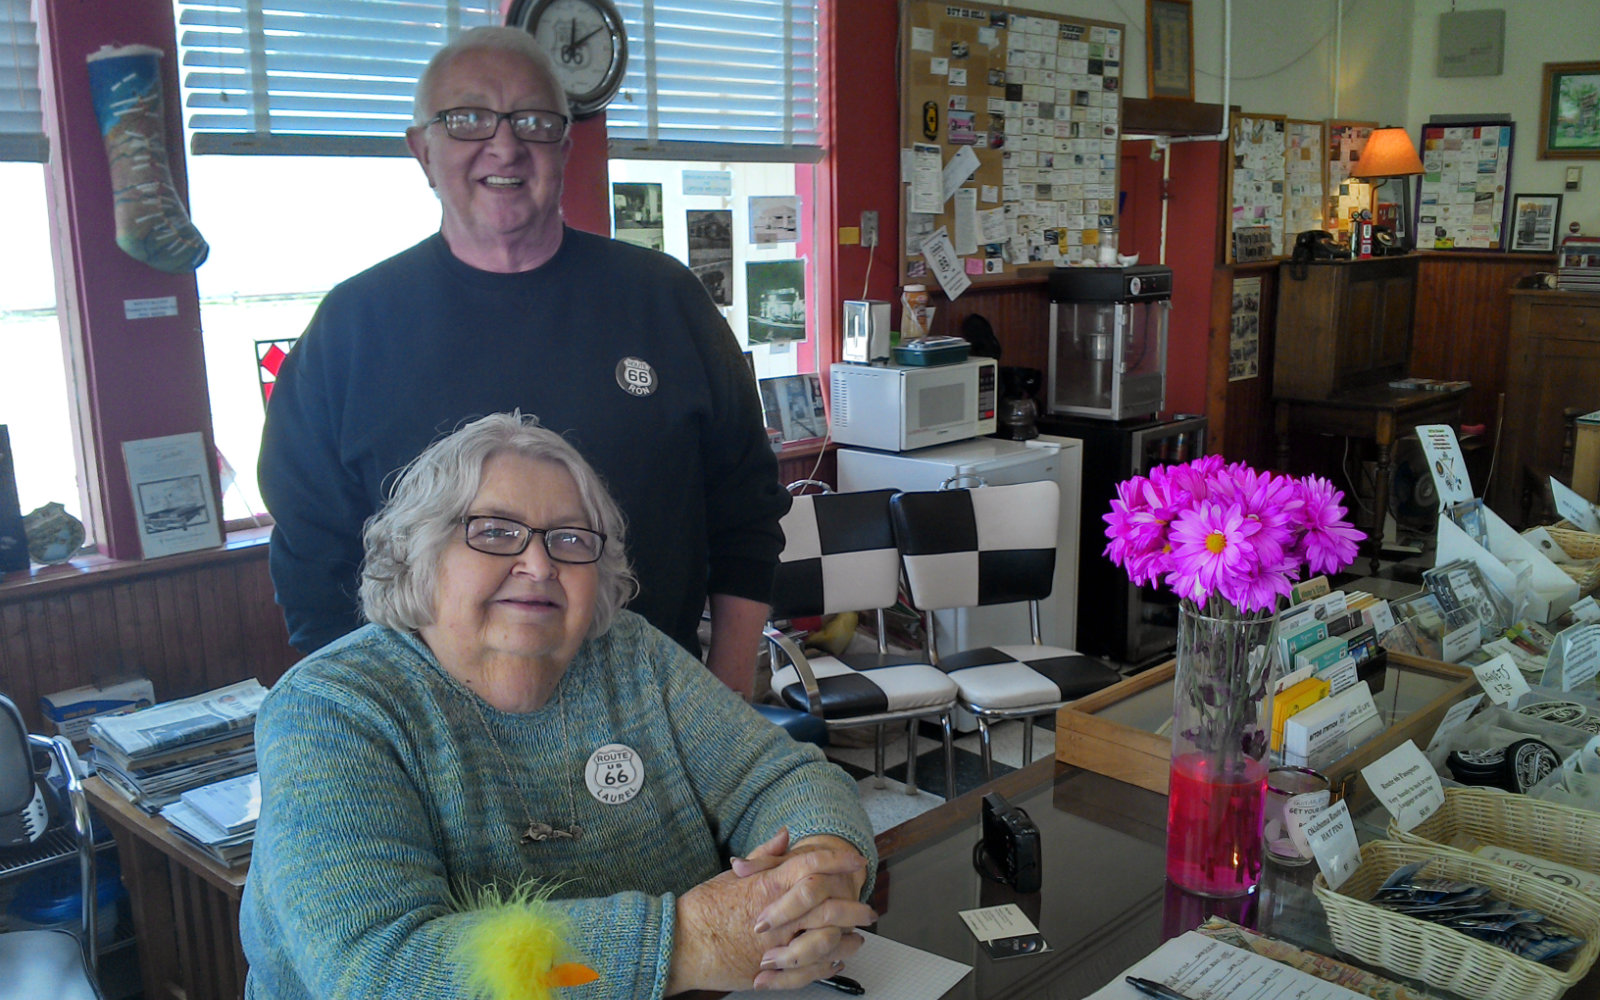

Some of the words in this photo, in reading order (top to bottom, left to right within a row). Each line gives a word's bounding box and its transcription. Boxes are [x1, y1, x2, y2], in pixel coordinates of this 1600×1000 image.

[628, 369, 648, 384] 66
[628, 384, 650, 395] RON
[597, 752, 629, 762] ROUTE
[604, 769, 629, 786] 66
[596, 786, 637, 803] LAUREL
[1307, 818, 1331, 836] Oklahoma
[1320, 829, 1333, 841] HAT
[1331, 822, 1344, 833] PINS
